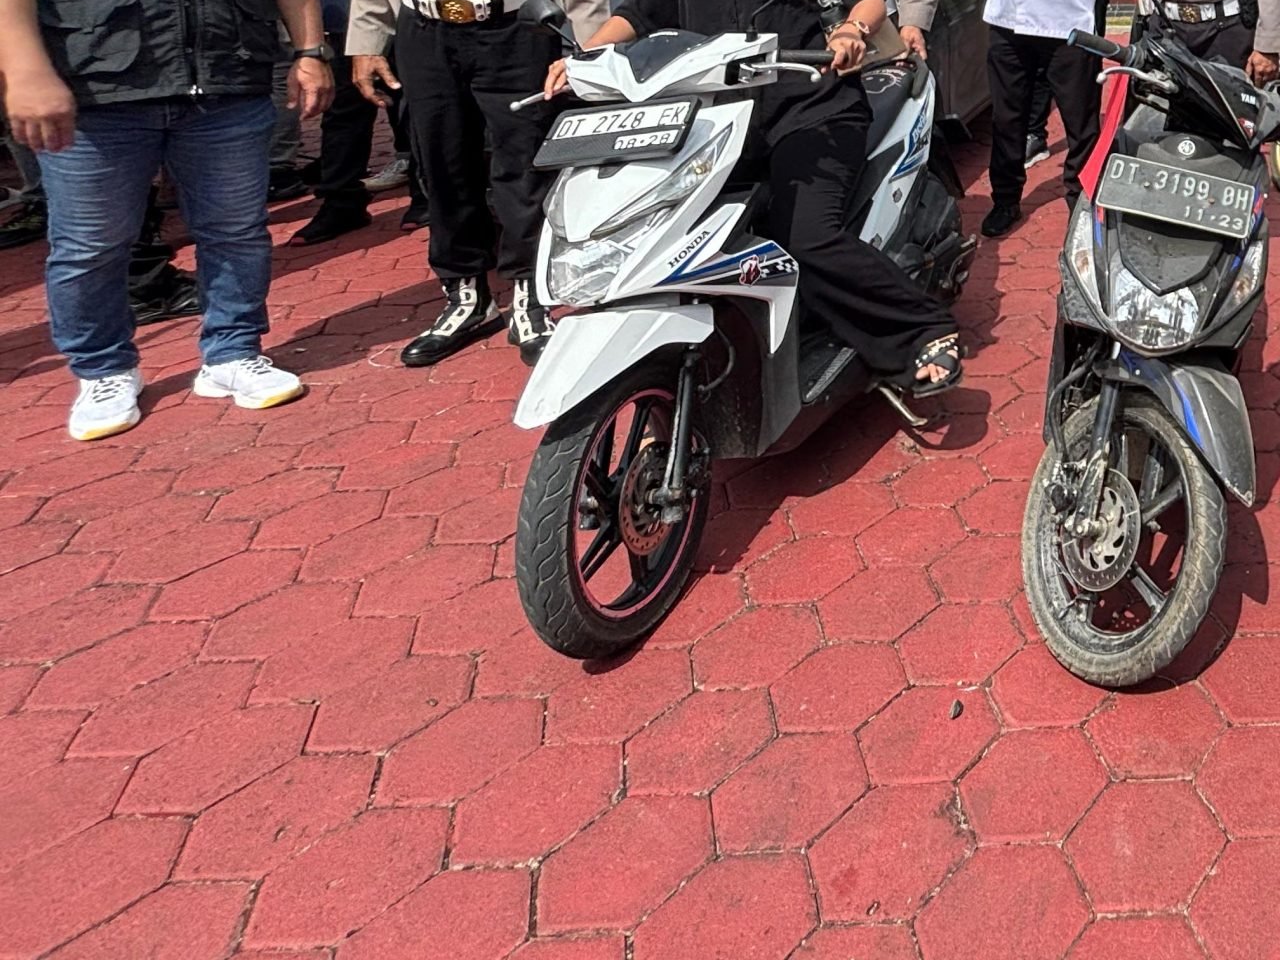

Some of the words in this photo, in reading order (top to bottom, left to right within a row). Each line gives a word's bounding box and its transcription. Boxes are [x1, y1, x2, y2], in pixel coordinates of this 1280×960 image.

[556, 118, 587, 138] DT
[592, 111, 646, 134] 2748
[1110, 159, 1140, 185] DT
[1153, 170, 1211, 201] 3199
[667, 230, 711, 269] HONDA
